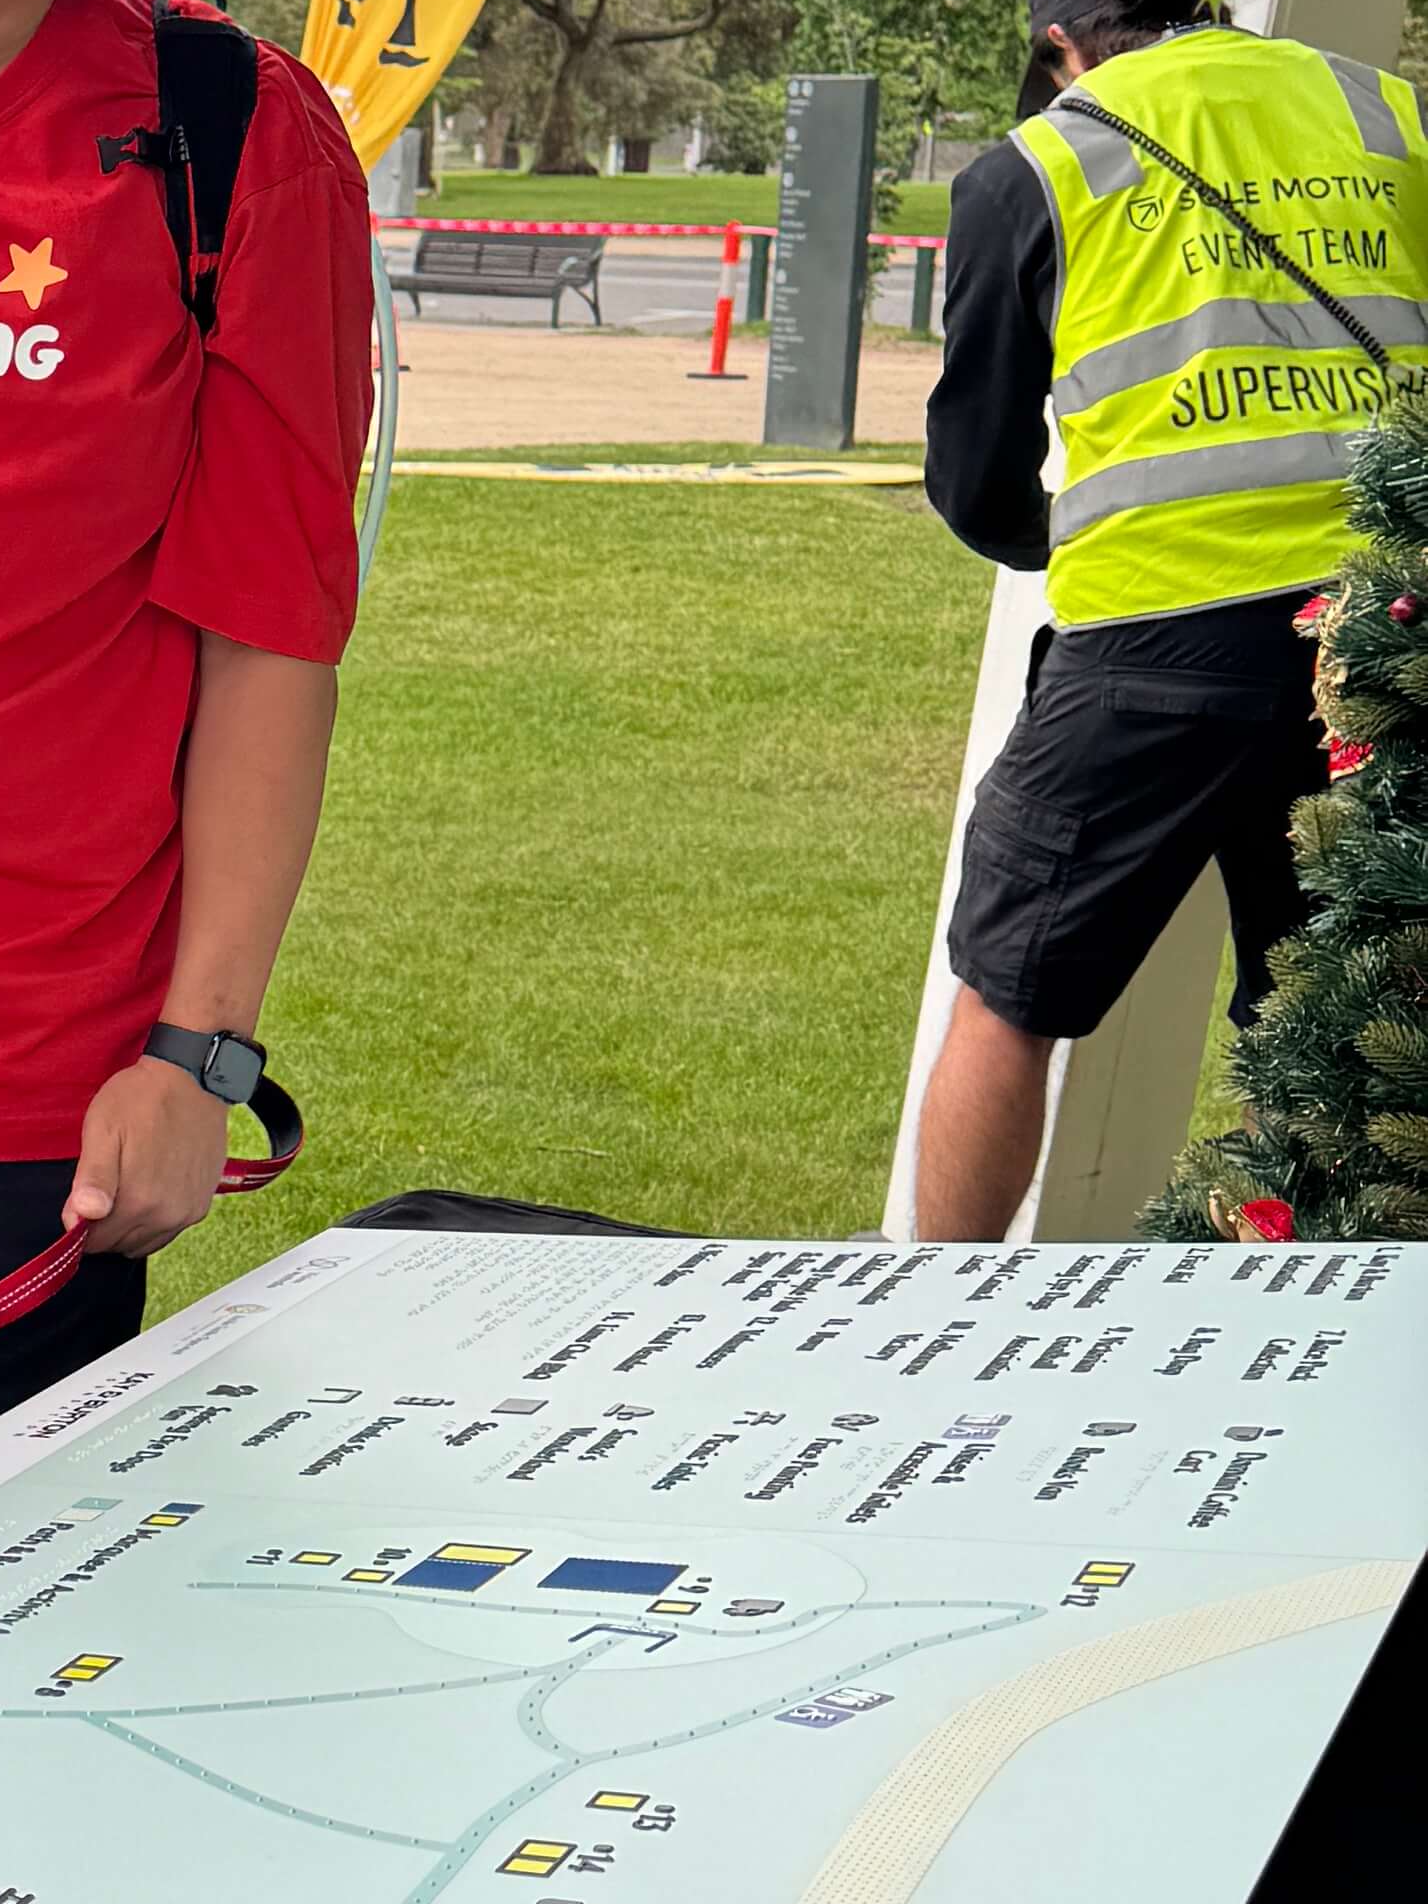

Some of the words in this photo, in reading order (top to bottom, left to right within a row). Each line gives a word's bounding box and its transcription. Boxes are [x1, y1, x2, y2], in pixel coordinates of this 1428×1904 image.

[1272, 175, 1396, 203] MOTIVE
[1297, 227, 1388, 270] TEAM
[110, 1371, 154, 1391] KAY
[27, 1398, 108, 1439] BURTON
[157, 1404, 205, 1421] Van
[164, 1404, 232, 1434] Seeing
[145, 1433, 189, 1450] Eye
[239, 1410, 312, 1447] Gantries
[345, 1415, 405, 1444] Drinks
[443, 1420, 499, 1447] Stage
[504, 1425, 597, 1481] Wonderland
[576, 1427, 638, 1461] Santa's
[684, 1432, 740, 1461] Picnic
[795, 1436, 843, 1460] Face
[108, 1449, 163, 1473] Dogs
[297, 1442, 365, 1476] Station
[876, 1440, 948, 1491] Accessible
[1051, 1446, 1105, 1480] Brooks
[1171, 1449, 1217, 1474] Cart
[1210, 1451, 1268, 1492] Domain
[649, 1460, 709, 1491] Tables
[742, 1459, 819, 1501] Painting
[1032, 1479, 1078, 1501] Van
[844, 1490, 903, 1524] Toilets
[1185, 1491, 1239, 1528] Coffee
[17, 1521, 75, 1545] Path
[1, 1544, 36, 1555] &
[75, 1527, 161, 1573] Marquee
[57, 1572, 93, 1582] &
[676, 1584, 709, 1594] 9
[1058, 1593, 1099, 1608] 12
[33, 1686, 66, 1698] 8
[630, 1813, 676, 1832] 13
[566, 1853, 615, 1873] 14
